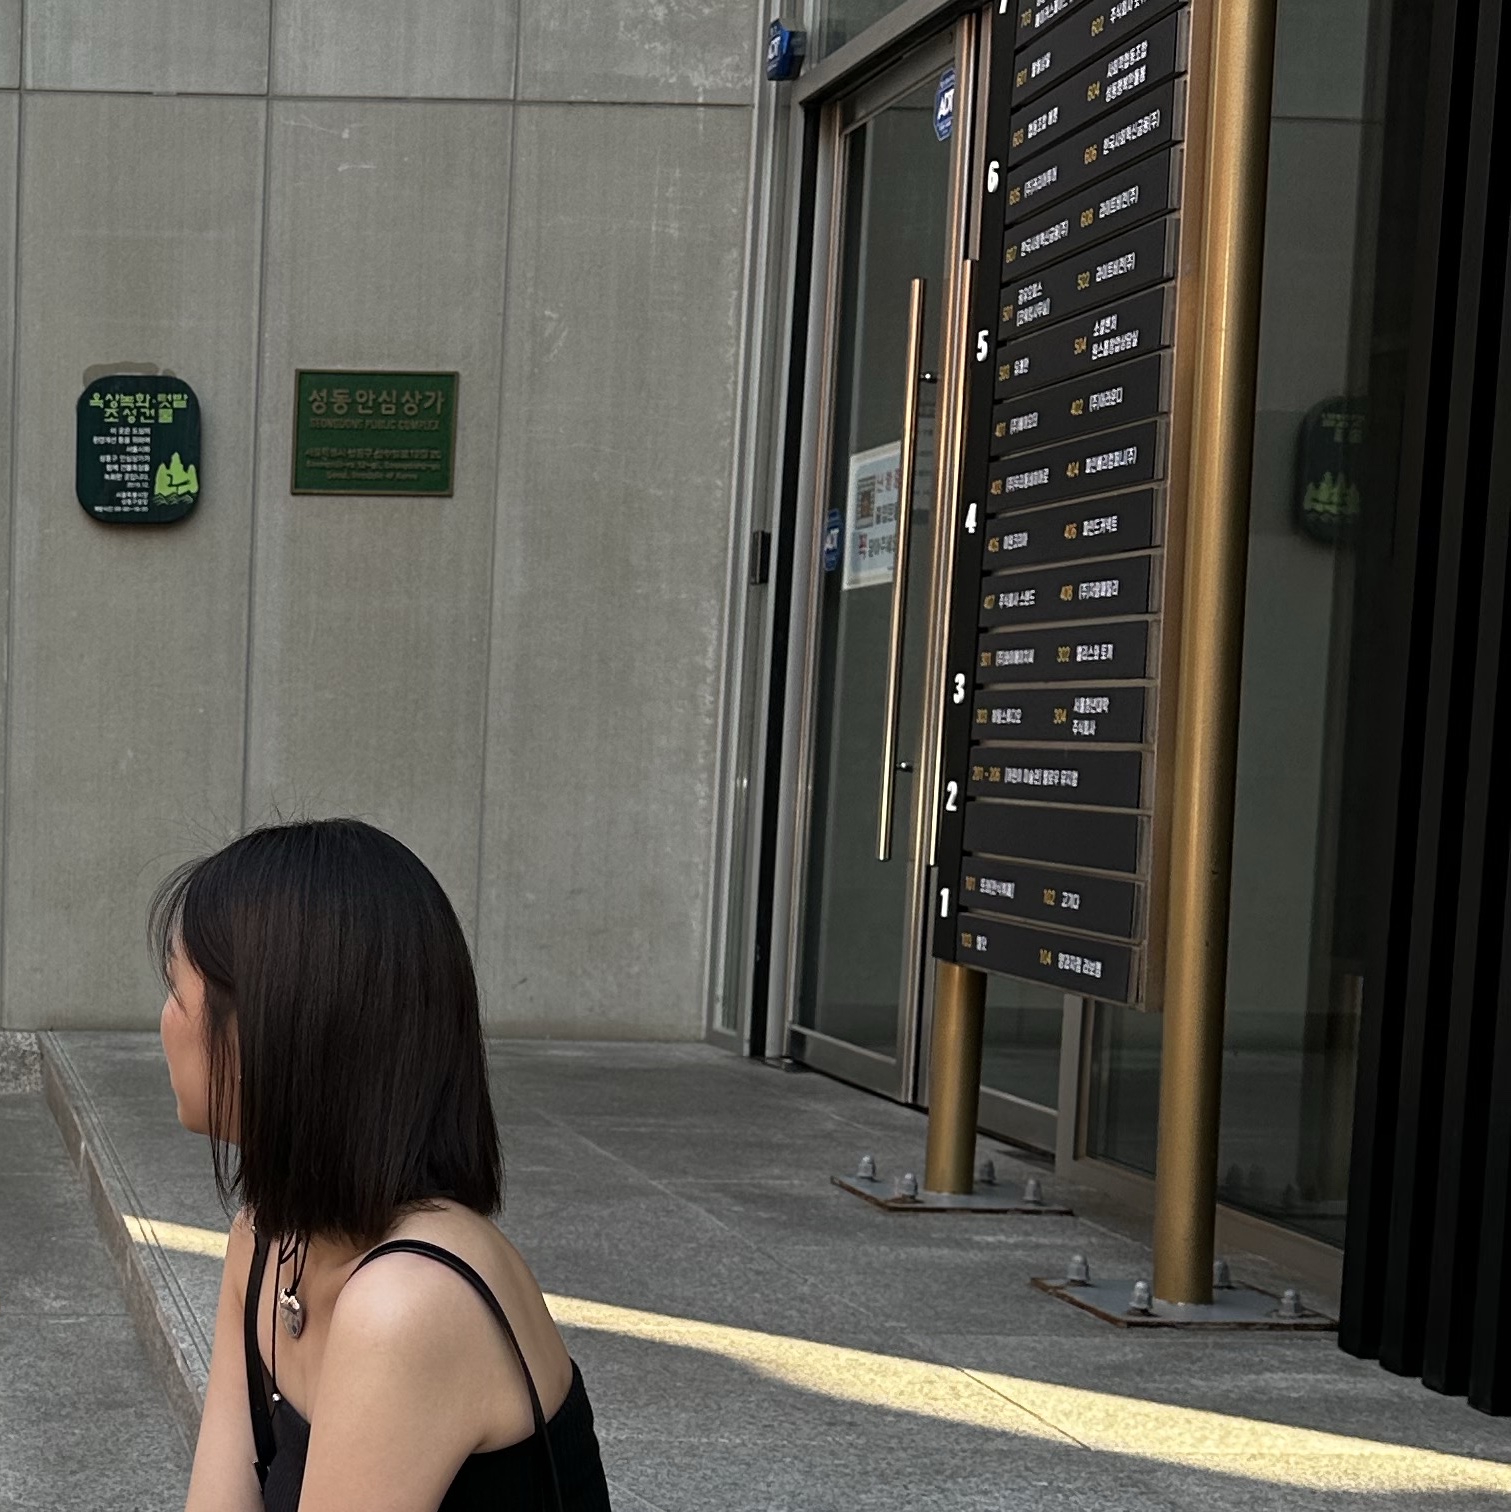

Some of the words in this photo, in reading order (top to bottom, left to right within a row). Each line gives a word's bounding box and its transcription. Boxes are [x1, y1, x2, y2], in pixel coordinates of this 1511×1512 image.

[988, 160, 999, 193] 6
[1093, 314, 1118, 337] 소셜벤처
[976, 330, 988, 361] 5
[309, 388, 444, 416] 성동안심상가
[965, 503, 977, 534] 4
[953, 673, 965, 704] 3
[946, 781, 958, 811] 2
[940, 888, 949, 917] 1
